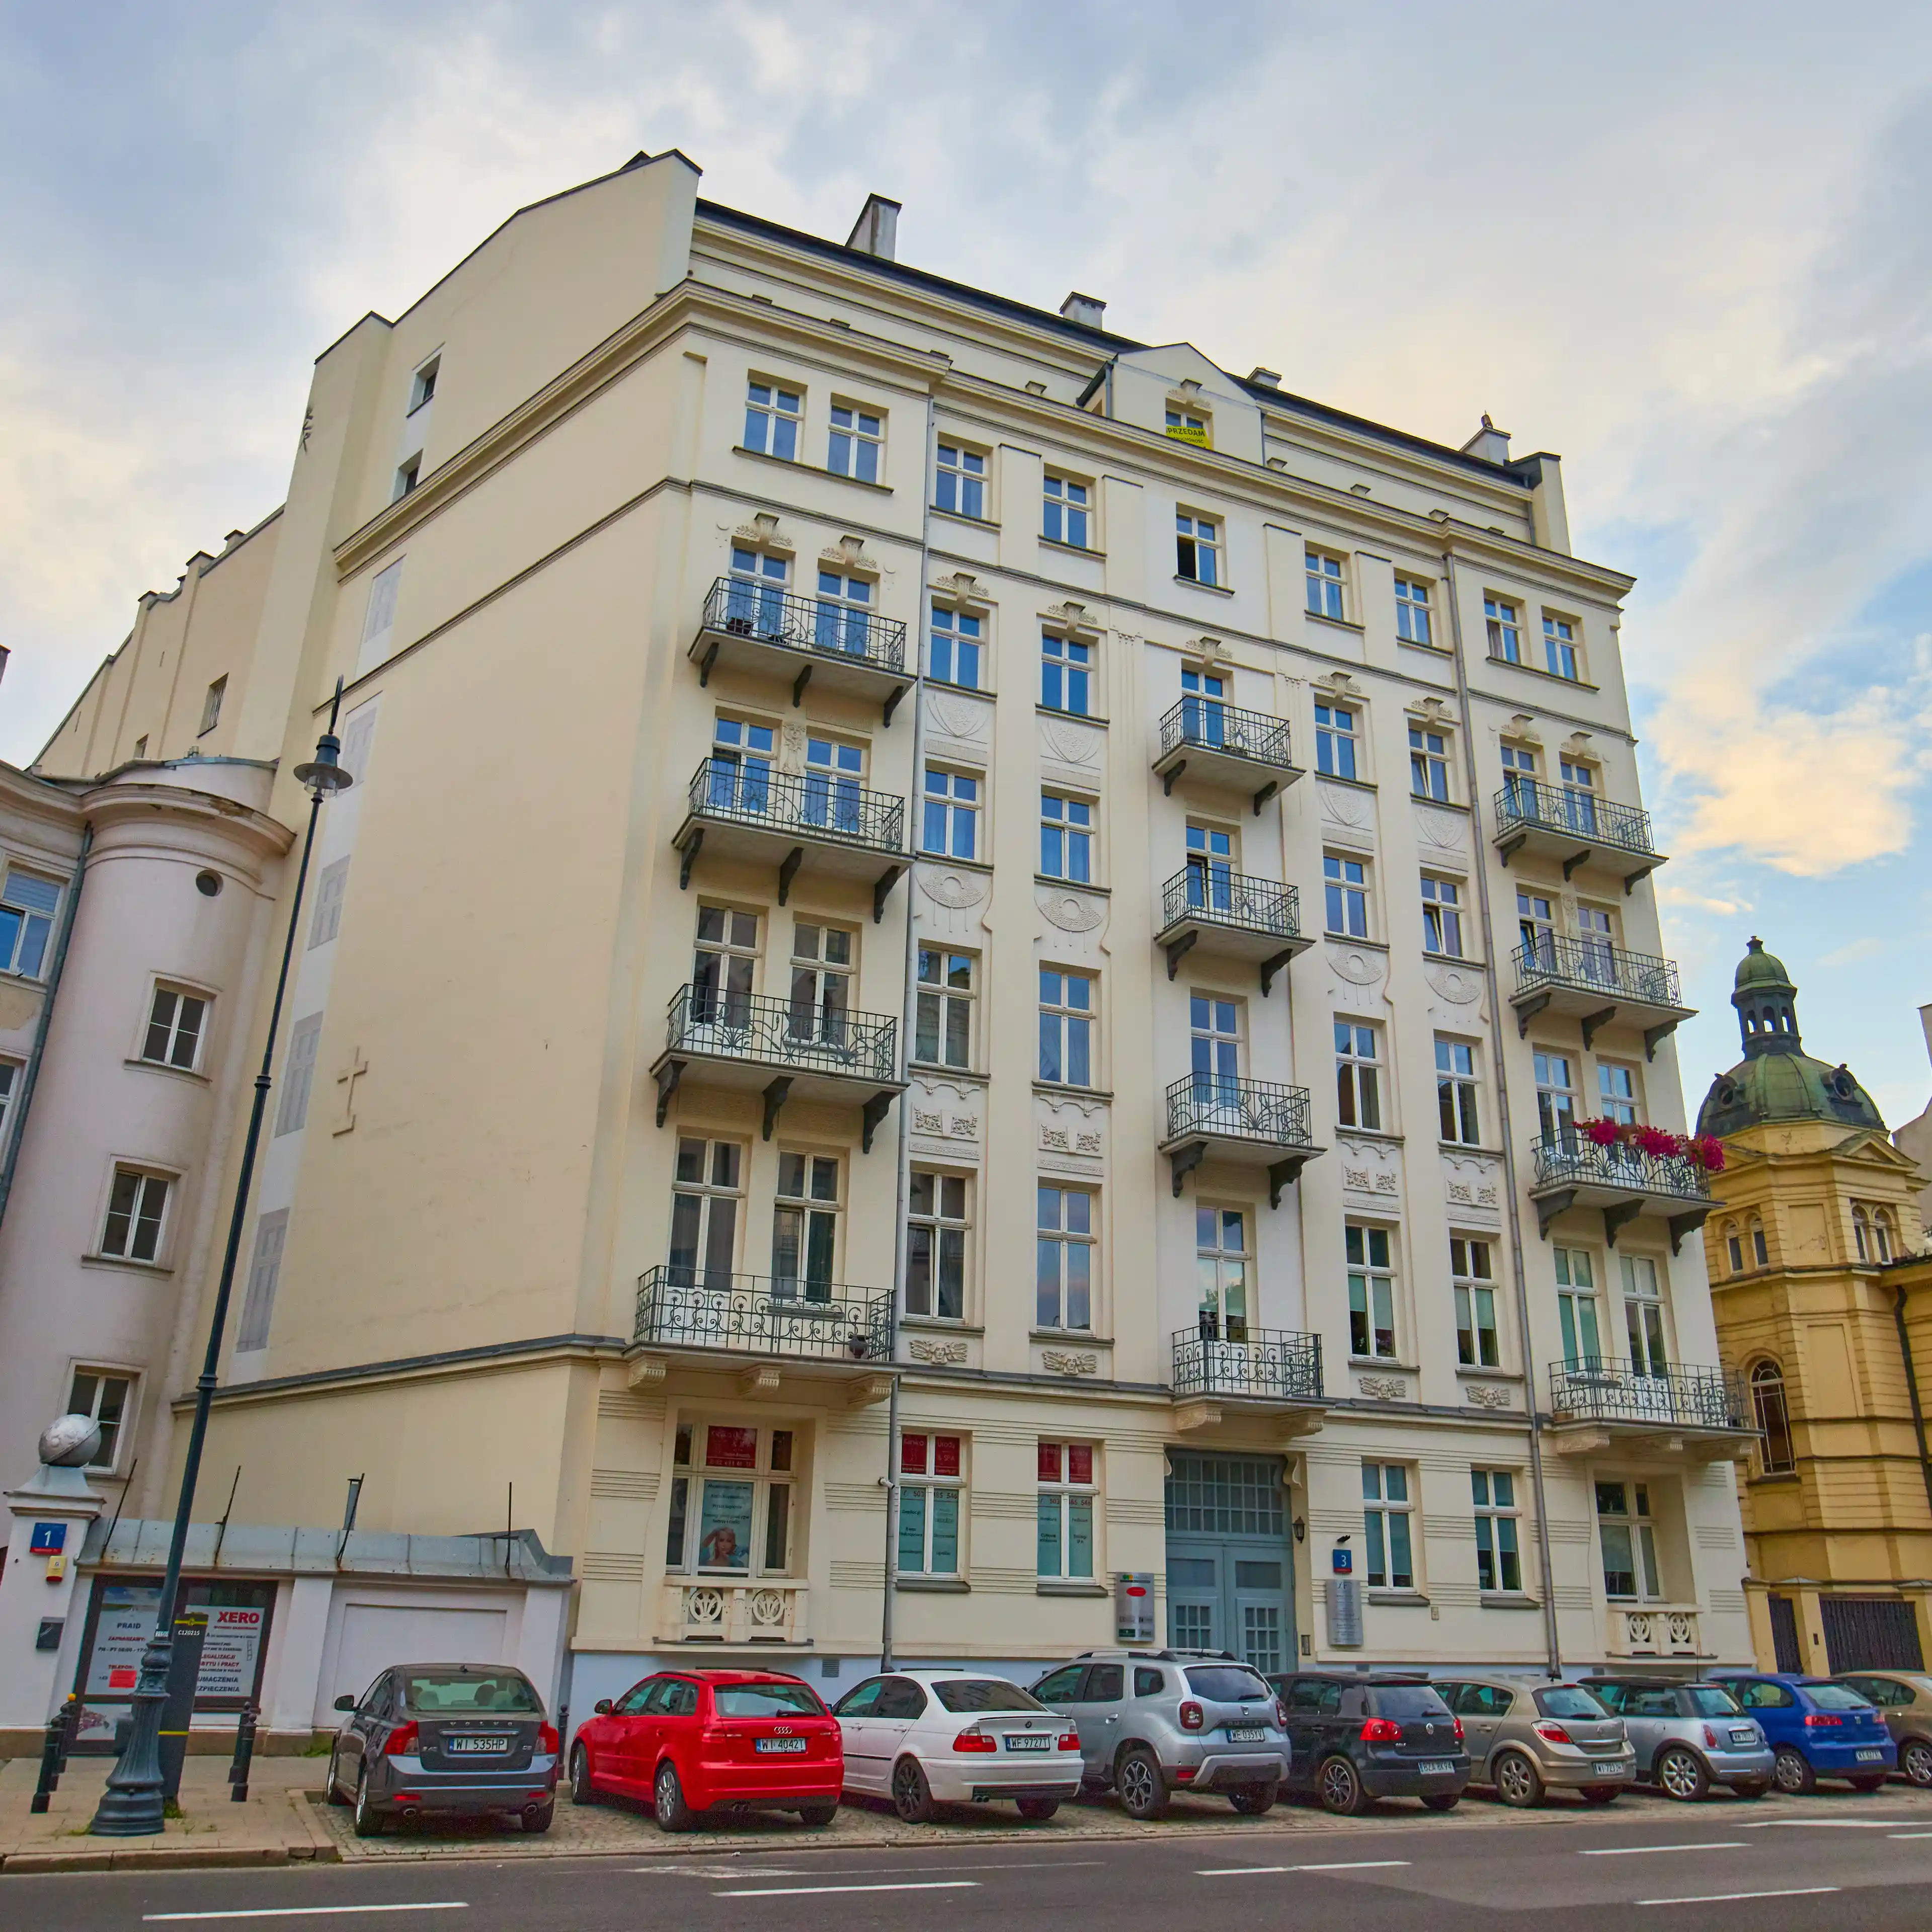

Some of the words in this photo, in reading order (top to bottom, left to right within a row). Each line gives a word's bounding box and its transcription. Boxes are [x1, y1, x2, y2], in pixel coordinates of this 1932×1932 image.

[44, 1530, 51, 1547] 1
[1341, 1555, 1347, 1567] 3
[217, 1612, 260, 1624] XERO
[456, 1739, 467, 1750] WI
[473, 1739, 505, 1750] 535HP
[762, 1739, 773, 1749] WI
[778, 1739, 804, 1749] 4042T
[1011, 1738, 1022, 1748] WF
[1024, 1738, 1048, 1748] 9727T
